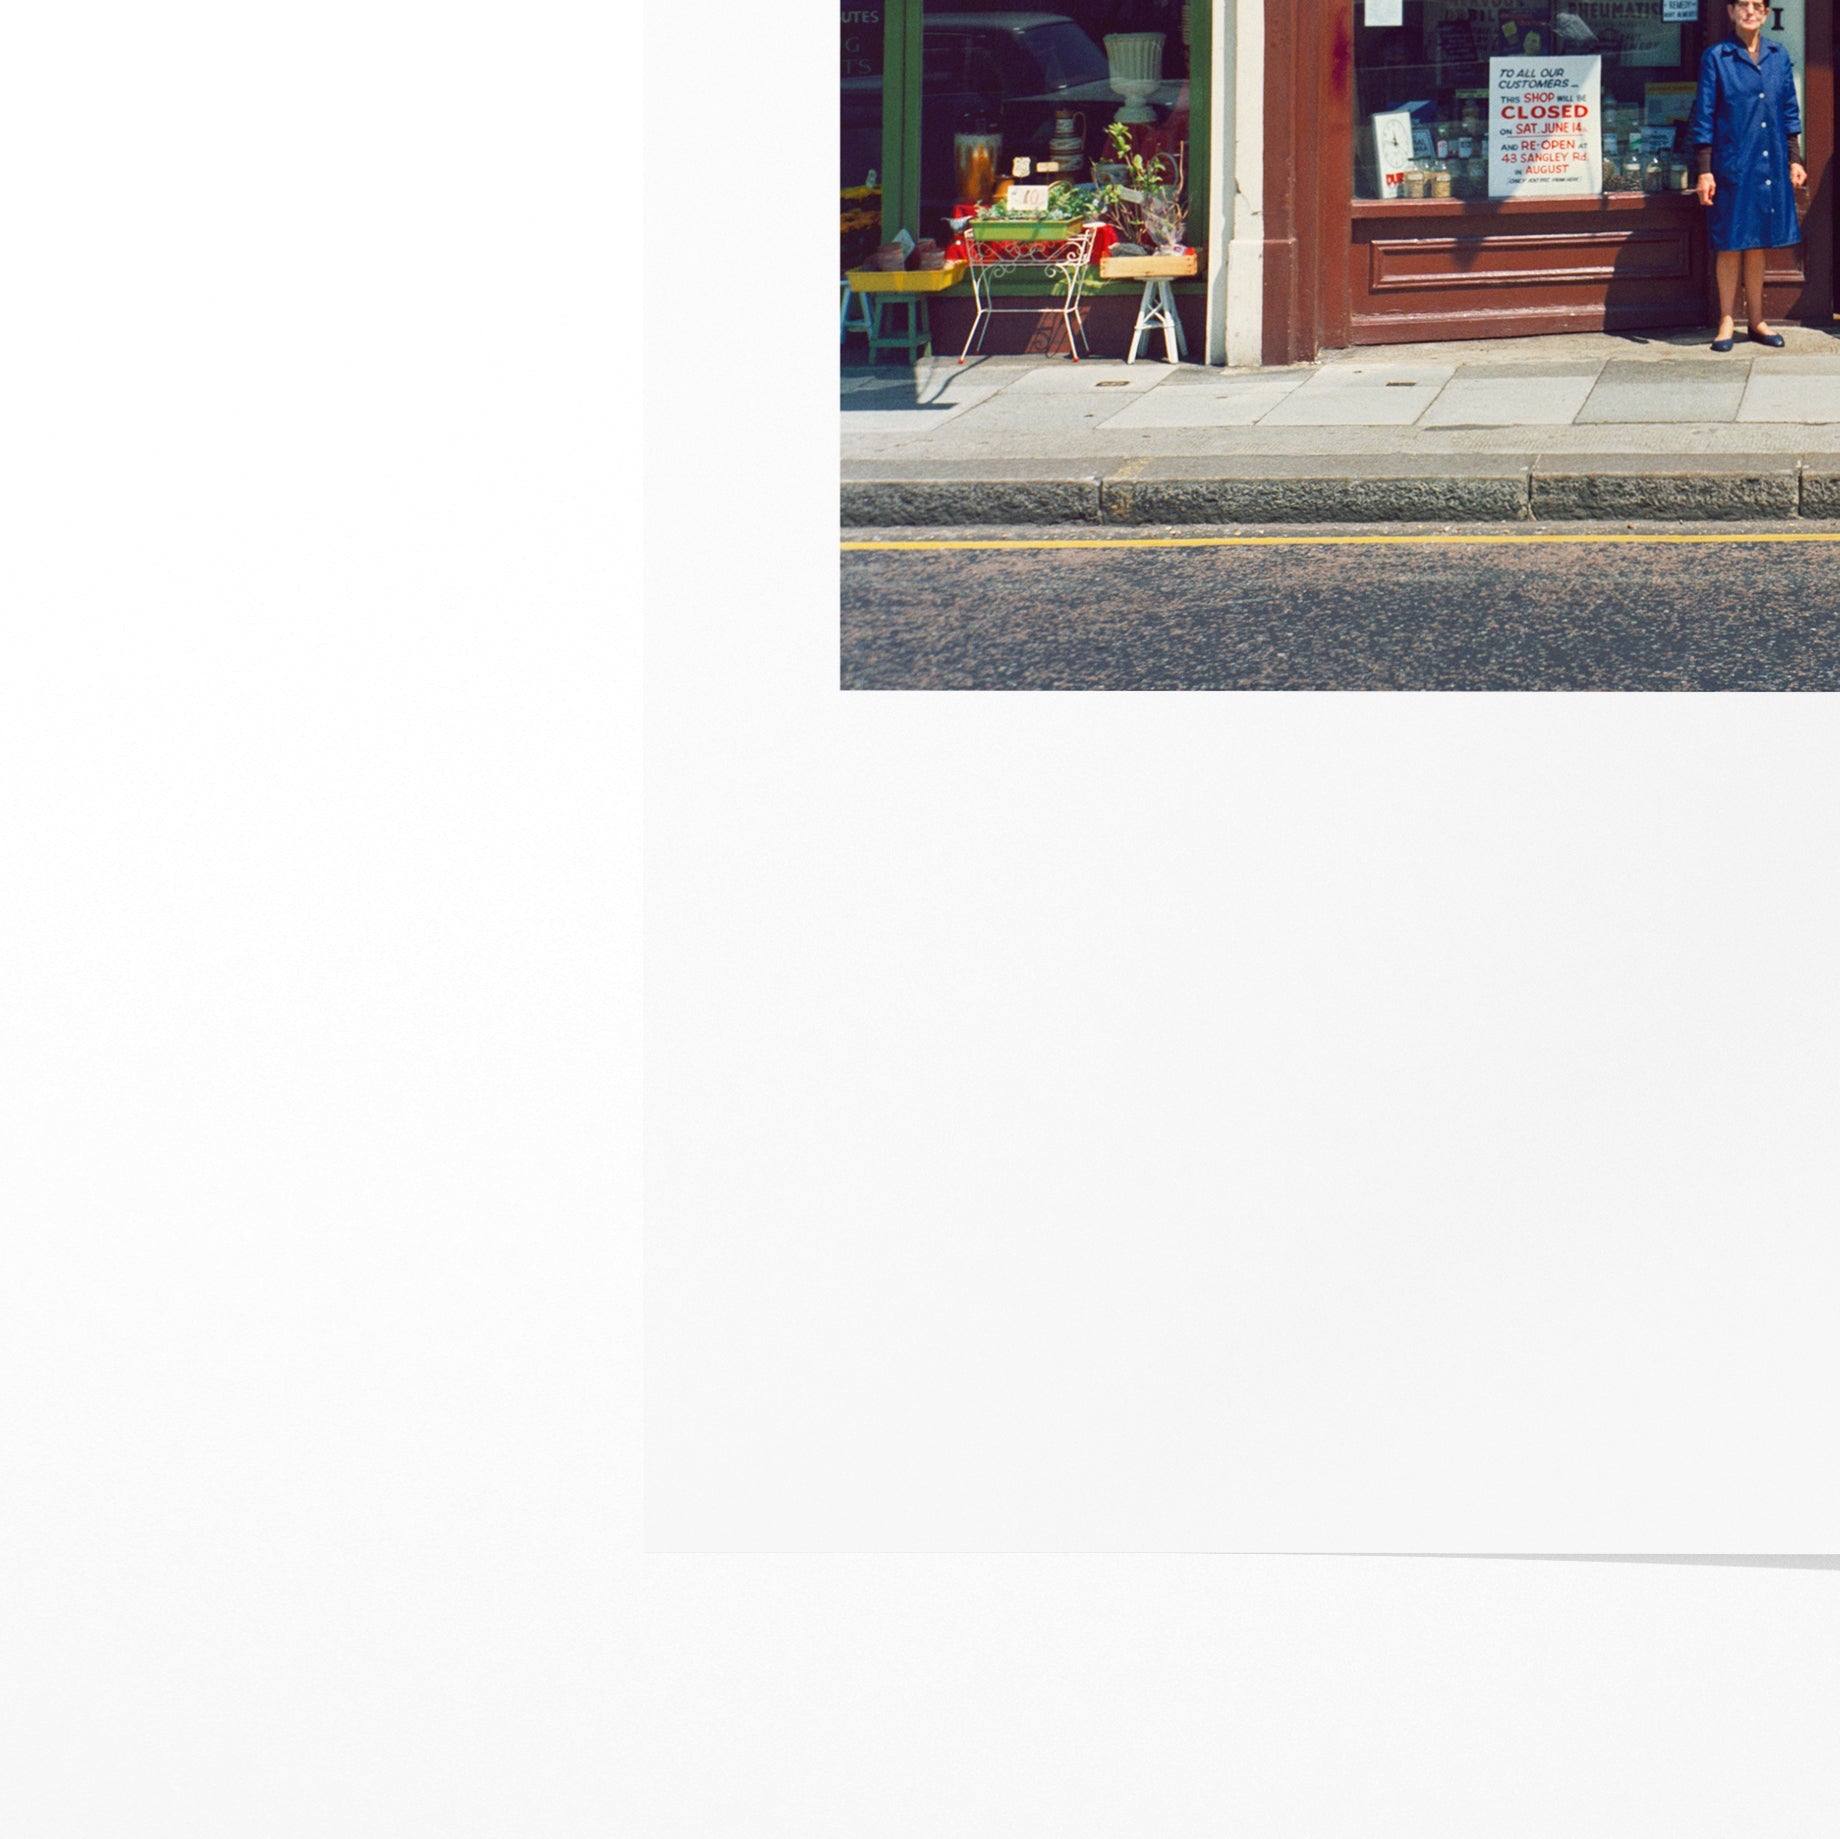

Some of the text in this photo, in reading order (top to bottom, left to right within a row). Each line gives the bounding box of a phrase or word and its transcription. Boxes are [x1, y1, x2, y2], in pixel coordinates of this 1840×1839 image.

[1499, 68, 1564, 78] TO ALL OUR
[1498, 79, 1569, 89] CUSTOMERS
[1524, 92, 1555, 103] SHOP
[1576, 94, 1586, 102] BE
[1501, 105, 1588, 119] CLOSED
[1541, 122, 1568, 134] JUNE
[1521, 140, 1575, 150] RE-OPEN
[1501, 154, 1517, 163] 43
[1521, 153, 1568, 163] SANGLEY
[1525, 165, 1568, 174] AUGUST
